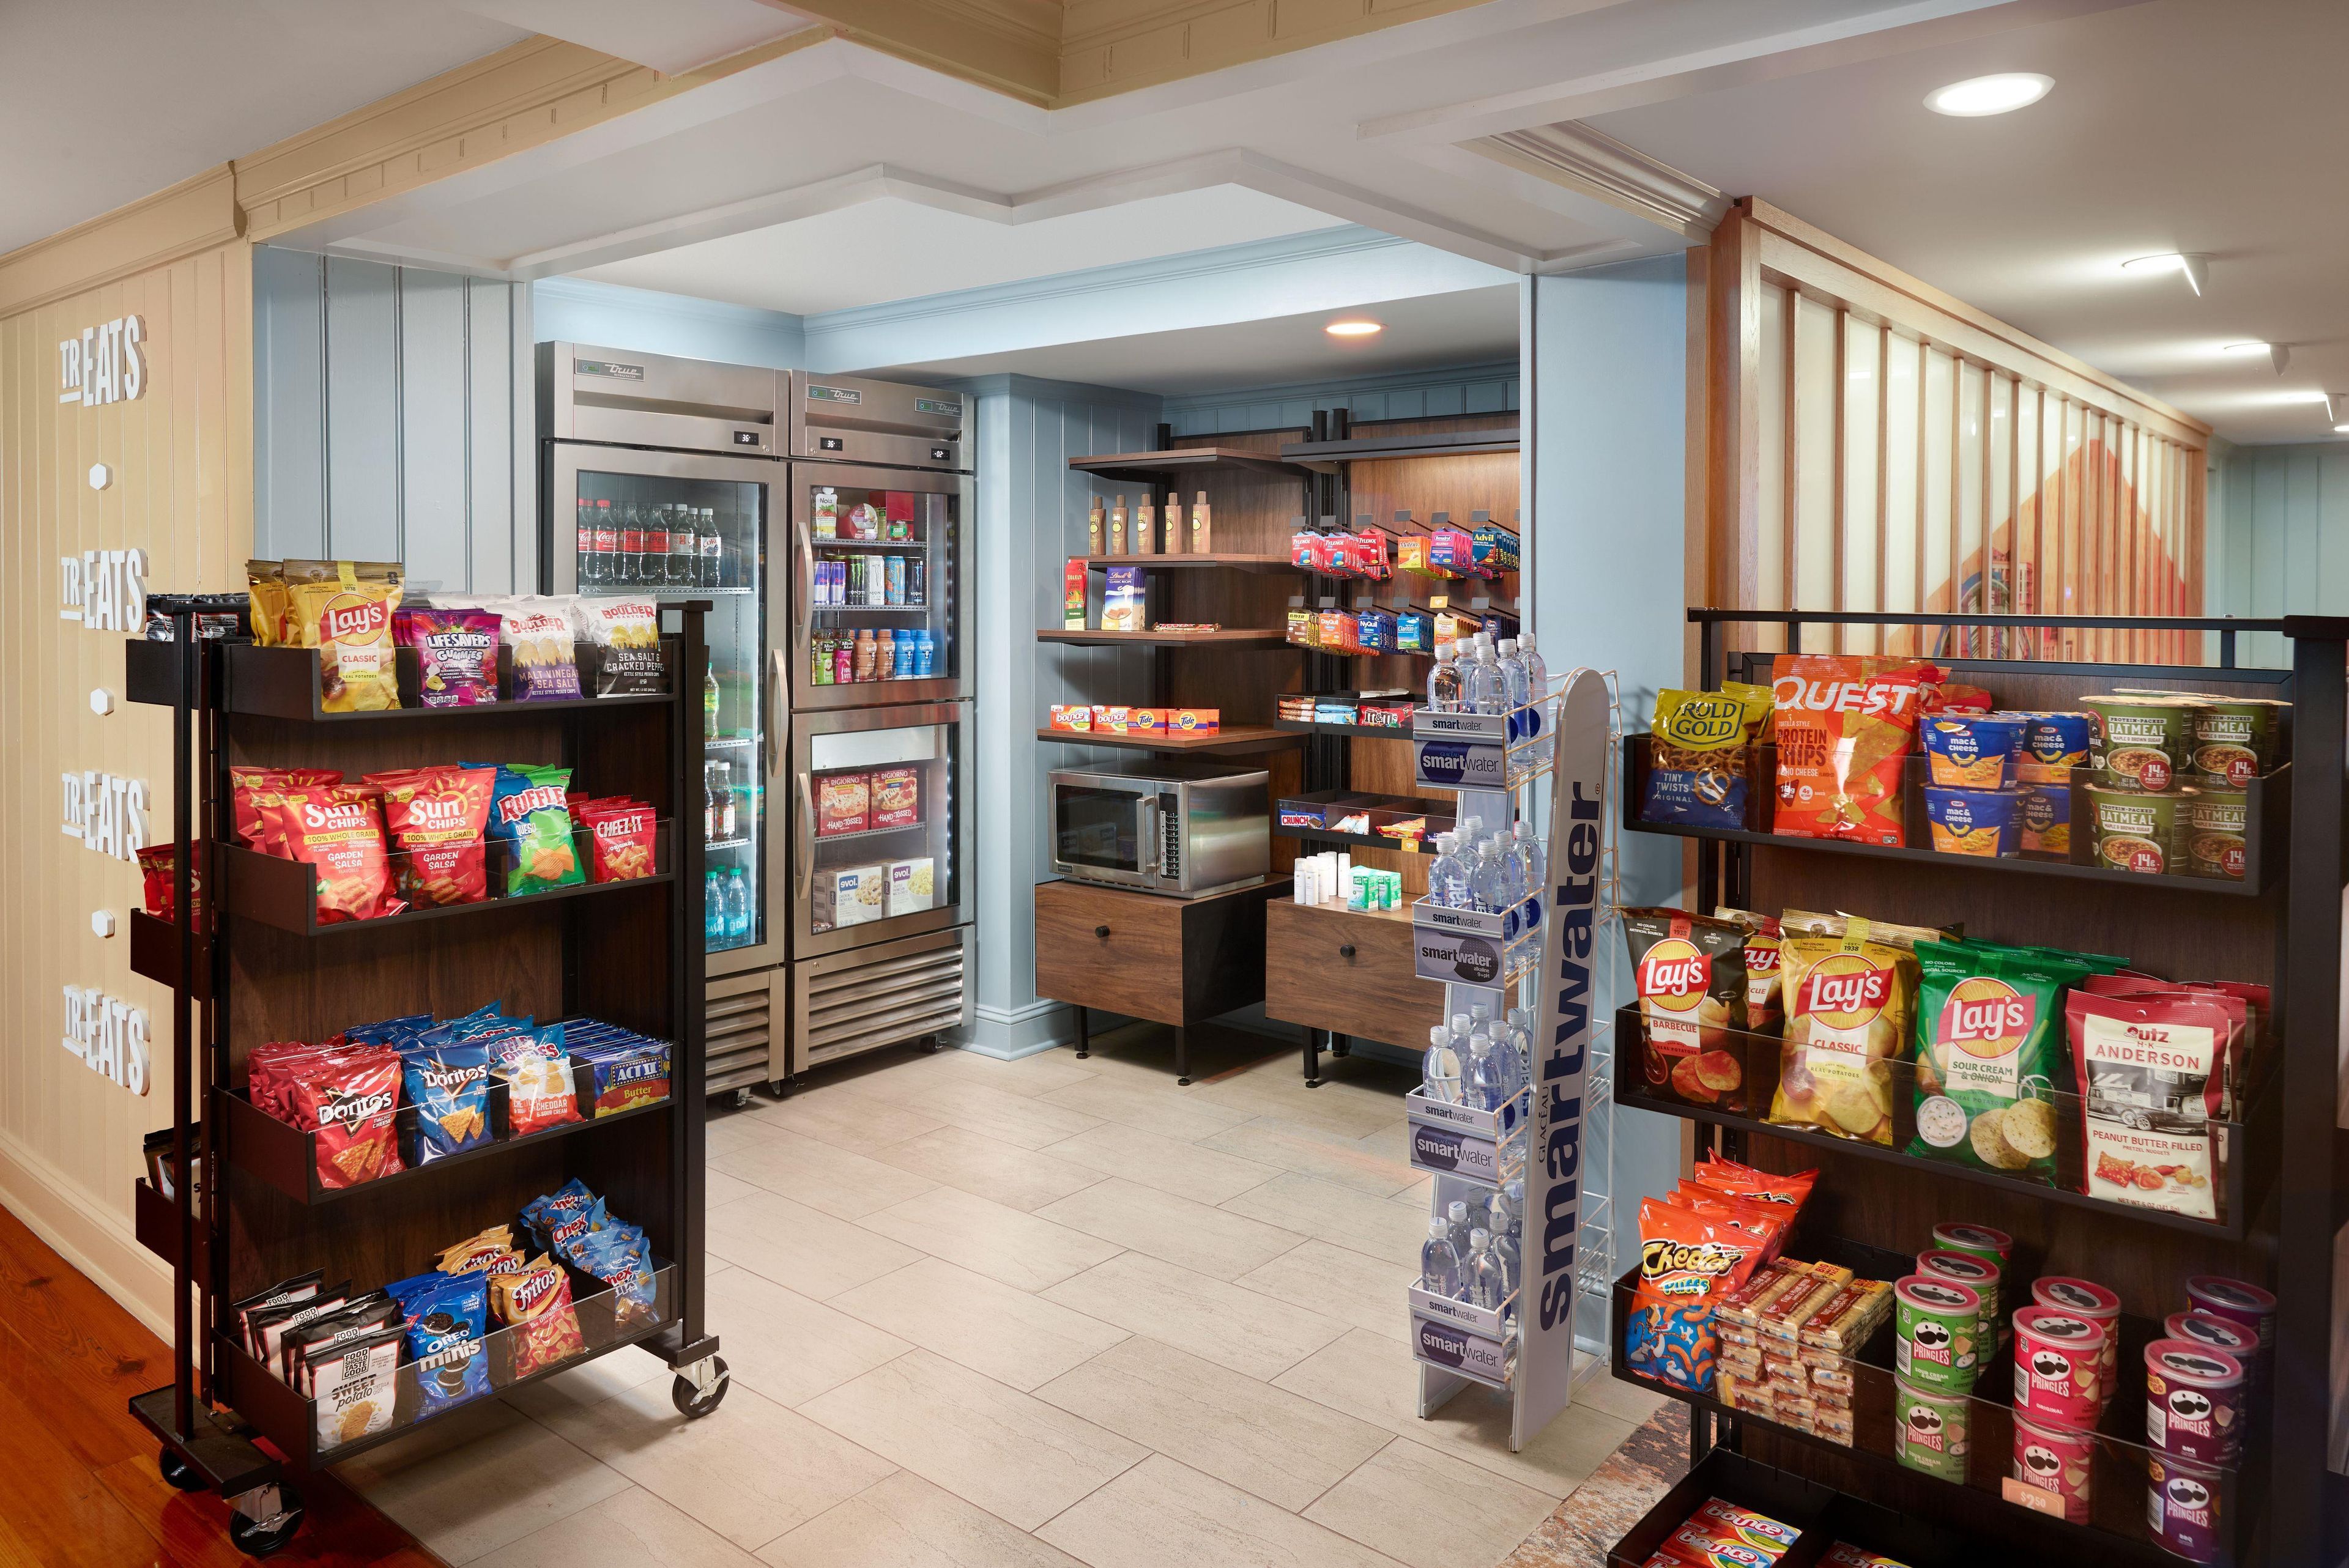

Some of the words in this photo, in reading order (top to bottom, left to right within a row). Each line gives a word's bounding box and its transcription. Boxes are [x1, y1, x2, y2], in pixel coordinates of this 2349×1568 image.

[60, 314, 146, 407] TREATS
[605, 364, 641, 375] true
[831, 390, 858, 399] true
[936, 403, 959, 412] true
[60, 548, 146, 632] TREATS
[328, 602, 384, 638] Lay's
[601, 605, 656, 619] BOULDER
[510, 618, 565, 634] BOULDER
[342, 654, 377, 664] CLASSIC
[519, 671, 543, 681] MALT
[557, 679, 576, 687] SALT
[1772, 676, 1919, 714] QUEST
[1057, 712, 1083, 722] bounce
[1097, 712, 1125, 723] bounce
[1682, 703, 1737, 720] ROLD
[1433, 719, 1482, 731] smartwater
[1676, 720, 1732, 736] GOLD
[2109, 723, 2165, 735] OATMEAL
[2195, 721, 2252, 733] OATMEAL
[1777, 729, 1827, 743] PROTEIN
[1776, 744, 1826, 766] CHIPS
[1423, 755, 1498, 772] smartwater
[1656, 782, 1689, 793] TWISTS
[61, 770, 149, 864] TREATS
[305, 804, 360, 827] Sun
[409, 800, 460, 825] Sun
[878, 810, 911, 822] HAND-TOSSED
[1282, 815, 1309, 825] CRUNCH
[2101, 810, 2154, 826] OATMEAL
[327, 817, 366, 829] CHIPS
[428, 817, 466, 829] CHIPS
[516, 823, 536, 835] QUESO
[827, 818, 862, 829] HAND-TOSSED
[330, 832, 355, 841] WHOLE
[328, 850, 363, 861] GARDEN
[423, 851, 459, 862] GARDEN
[335, 860, 362, 868] SALSA
[429, 860, 455, 870] SALSA
[1433, 913, 1482, 928] smartwater
[1422, 947, 1491, 967] smartwater
[1646, 956, 1703, 996] Lay's
[1809, 969, 1882, 1013] Lay's
[1952, 996, 2024, 1040] Lay's
[1653, 1020, 1697, 1033] BARBECUE
[62, 985, 149, 1095] TREATS
[1814, 1040, 1861, 1054] CLASSIC
[1540, 781, 1600, 1331] smartwater
[2095, 1045, 2199, 1070] ANDERSON
[427, 1065, 488, 1087] Doritos
[617, 1063, 640, 1081] ACT
[1828, 1070, 1860, 1078] POTATOES
[1953, 1061, 1978, 1071] SOUR
[1981, 1064, 2013, 1076] CREAM
[1971, 1073, 2002, 1084] ONION
[625, 1085, 652, 1100] Butter
[319, 1092, 392, 1124] Doritos
[536, 1100, 568, 1111] CHEDDAR
[1973, 1097, 2007, 1107] POTATOES
[1426, 1105, 1474, 1124] smartwater
[373, 1120, 392, 1129] CHEESE
[1539, 1087, 1549, 1163] GLACÉAU
[2093, 1130, 2128, 1144] PEANUT
[2131, 1137, 2169, 1149] BUTTER
[2172, 1142, 2202, 1152] FILLED
[1417, 1138, 1492, 1167] smartwater
[553, 1213, 588, 1243] Chex
[513, 1269, 555, 1311] Fritos
[268, 1294, 288, 1306] FOOD
[295, 1307, 316, 1321] FOOD
[539, 1300, 563, 1323] ORIGINAL
[1429, 1301, 1477, 1323] smartwater
[336, 1328, 358, 1340] FOOD
[428, 1328, 469, 1354] OREO
[345, 1349, 368, 1361] FOOD
[420, 1341, 481, 1371] minis
[1423, 1333, 1498, 1367] smartwater
[1913, 1344, 1950, 1365] PRINGLES
[345, 1355, 368, 1366] SHOULD
[345, 1361, 367, 1372] TASTE
[2032, 1374, 2069, 1397] PRINGLES
[336, 1387, 373, 1411] potato
[2036, 1403, 2064, 1415] ORIGINAL
[2169, 1415, 2210, 1437] PRINGLES
[1908, 1427, 1942, 1450] PRINGLES
[2024, 1469, 2059, 1493] PRINGLES
[1705, 1505, 1784, 1536] bounce
[2167, 1503, 2208, 1527] PRINGLES
[1676, 1530, 1759, 1562] bounce
